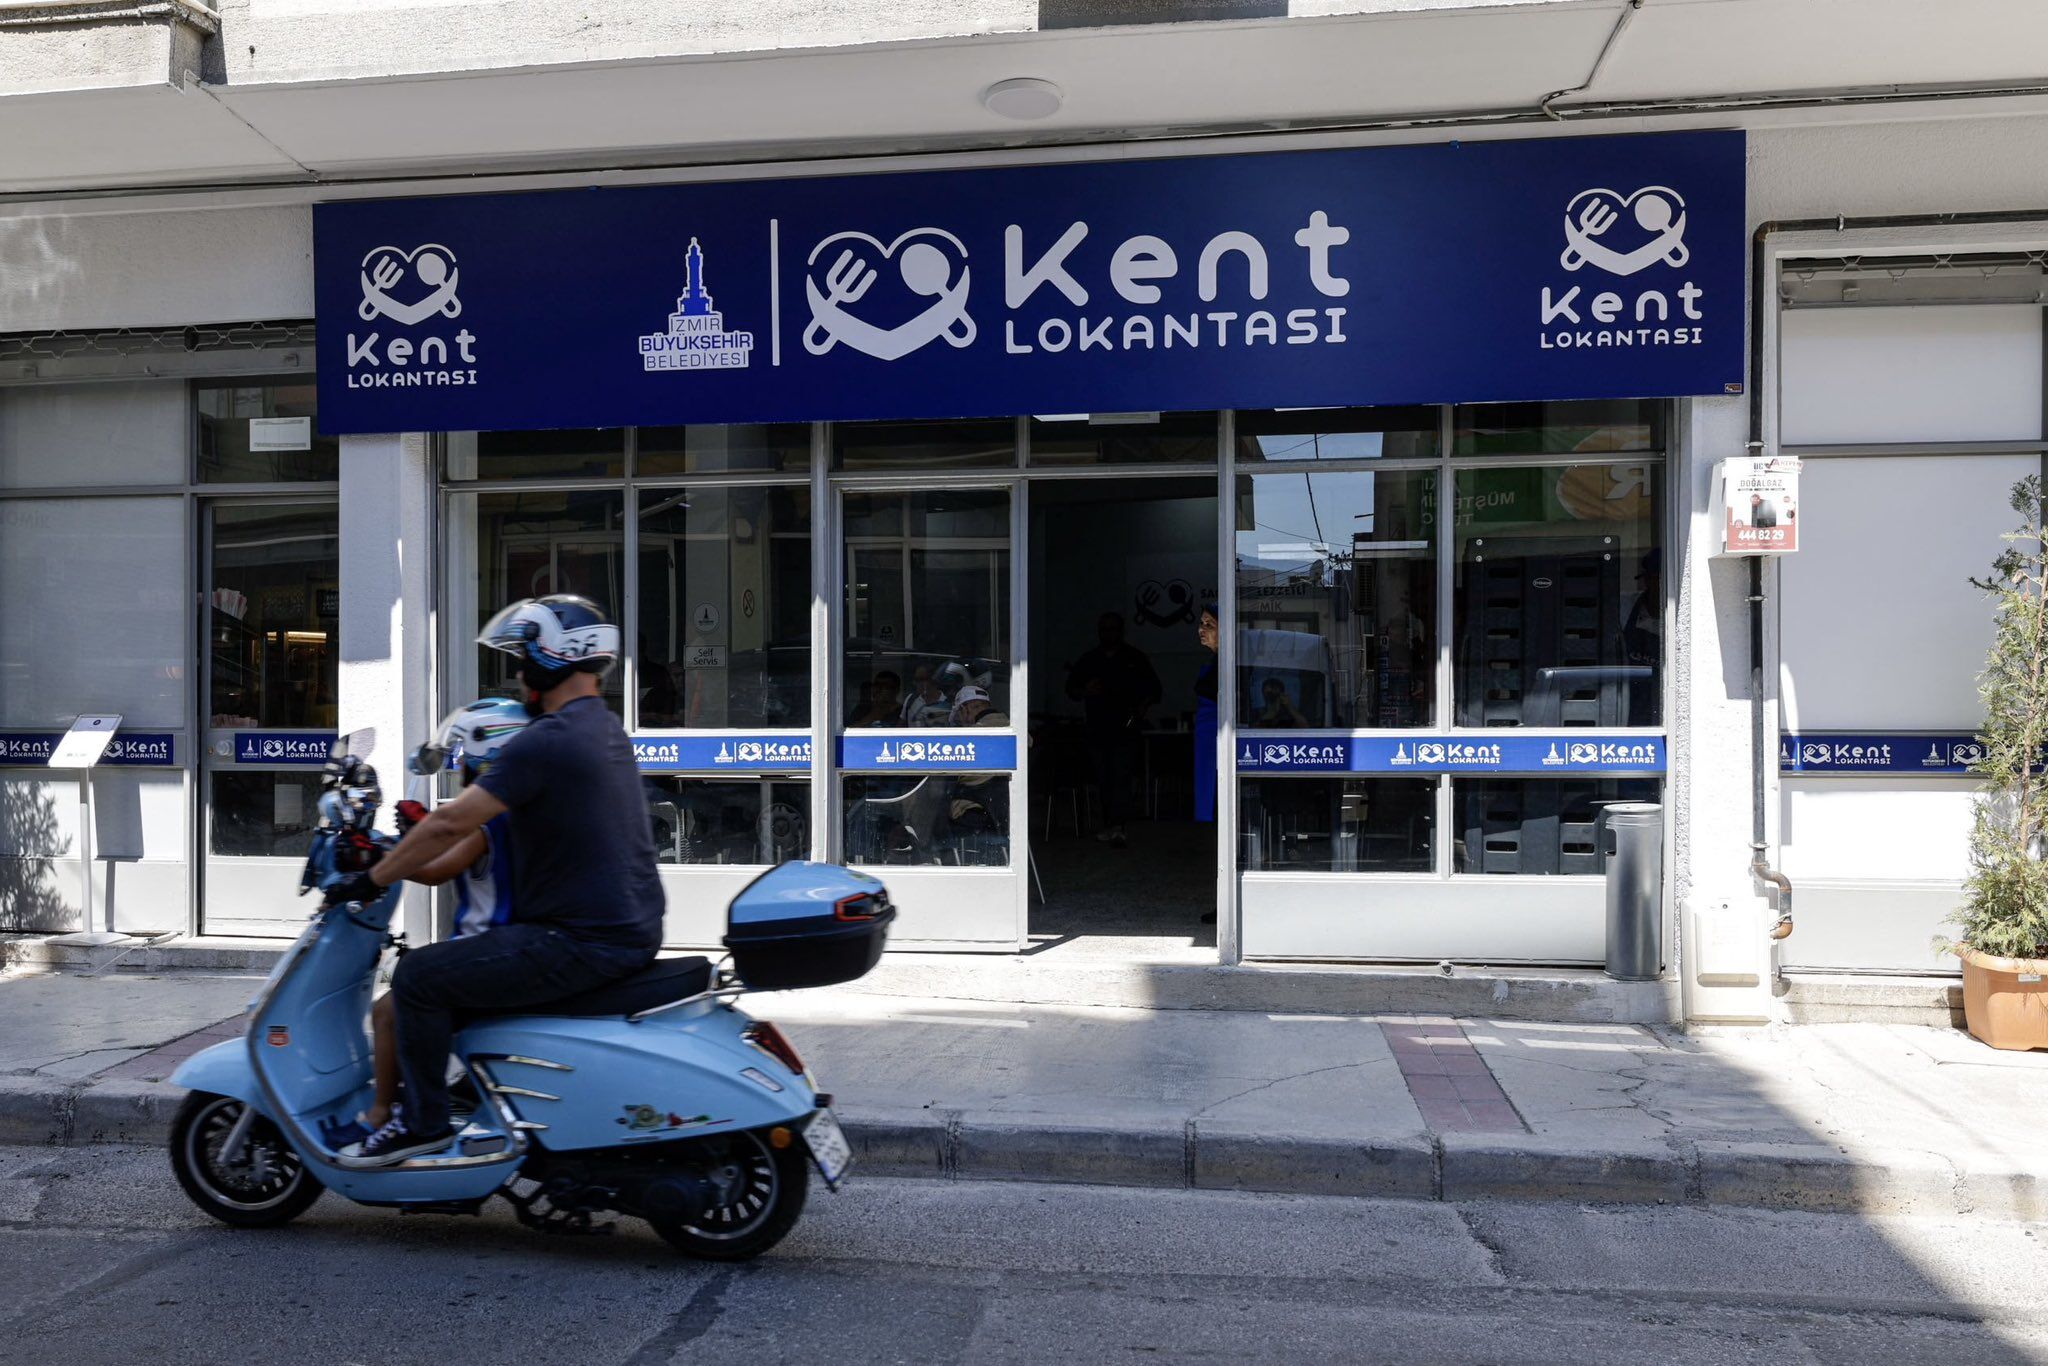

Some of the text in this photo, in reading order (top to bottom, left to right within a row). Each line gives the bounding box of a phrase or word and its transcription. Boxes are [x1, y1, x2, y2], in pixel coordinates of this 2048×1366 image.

[1004, 210, 1351, 309] Kent
[1541, 281, 1703, 325] Kent
[1005, 307, 1347, 354] LOKANTASI
[640, 332, 751, 352] BÜYÜKŞEHİR
[1540, 327, 1702, 349] LOKANTASI
[347, 328, 477, 367] Kent
[646, 350, 746, 369] BELEDİYESİ
[348, 369, 477, 388] LOKANTASI
[1738, 529, 1756, 541] 444
[1758, 529, 1771, 541] 82
[697, 647, 714, 657] Self
[693, 656, 718, 666] Servis
[9, 740, 50, 752] Kent
[126, 741, 167, 753] Kent
[286, 740, 327, 752] Kent
[633, 743, 679, 756] Kent
[764, 742, 811, 755] Kent
[927, 742, 976, 755] Kent
[1293, 744, 1344, 757] Kent
[1447, 744, 1501, 757] Kent
[1601, 743, 1655, 757] Kent
[1834, 744, 1891, 757] Kent
[1834, 757, 1891, 765] LOKANTASI
